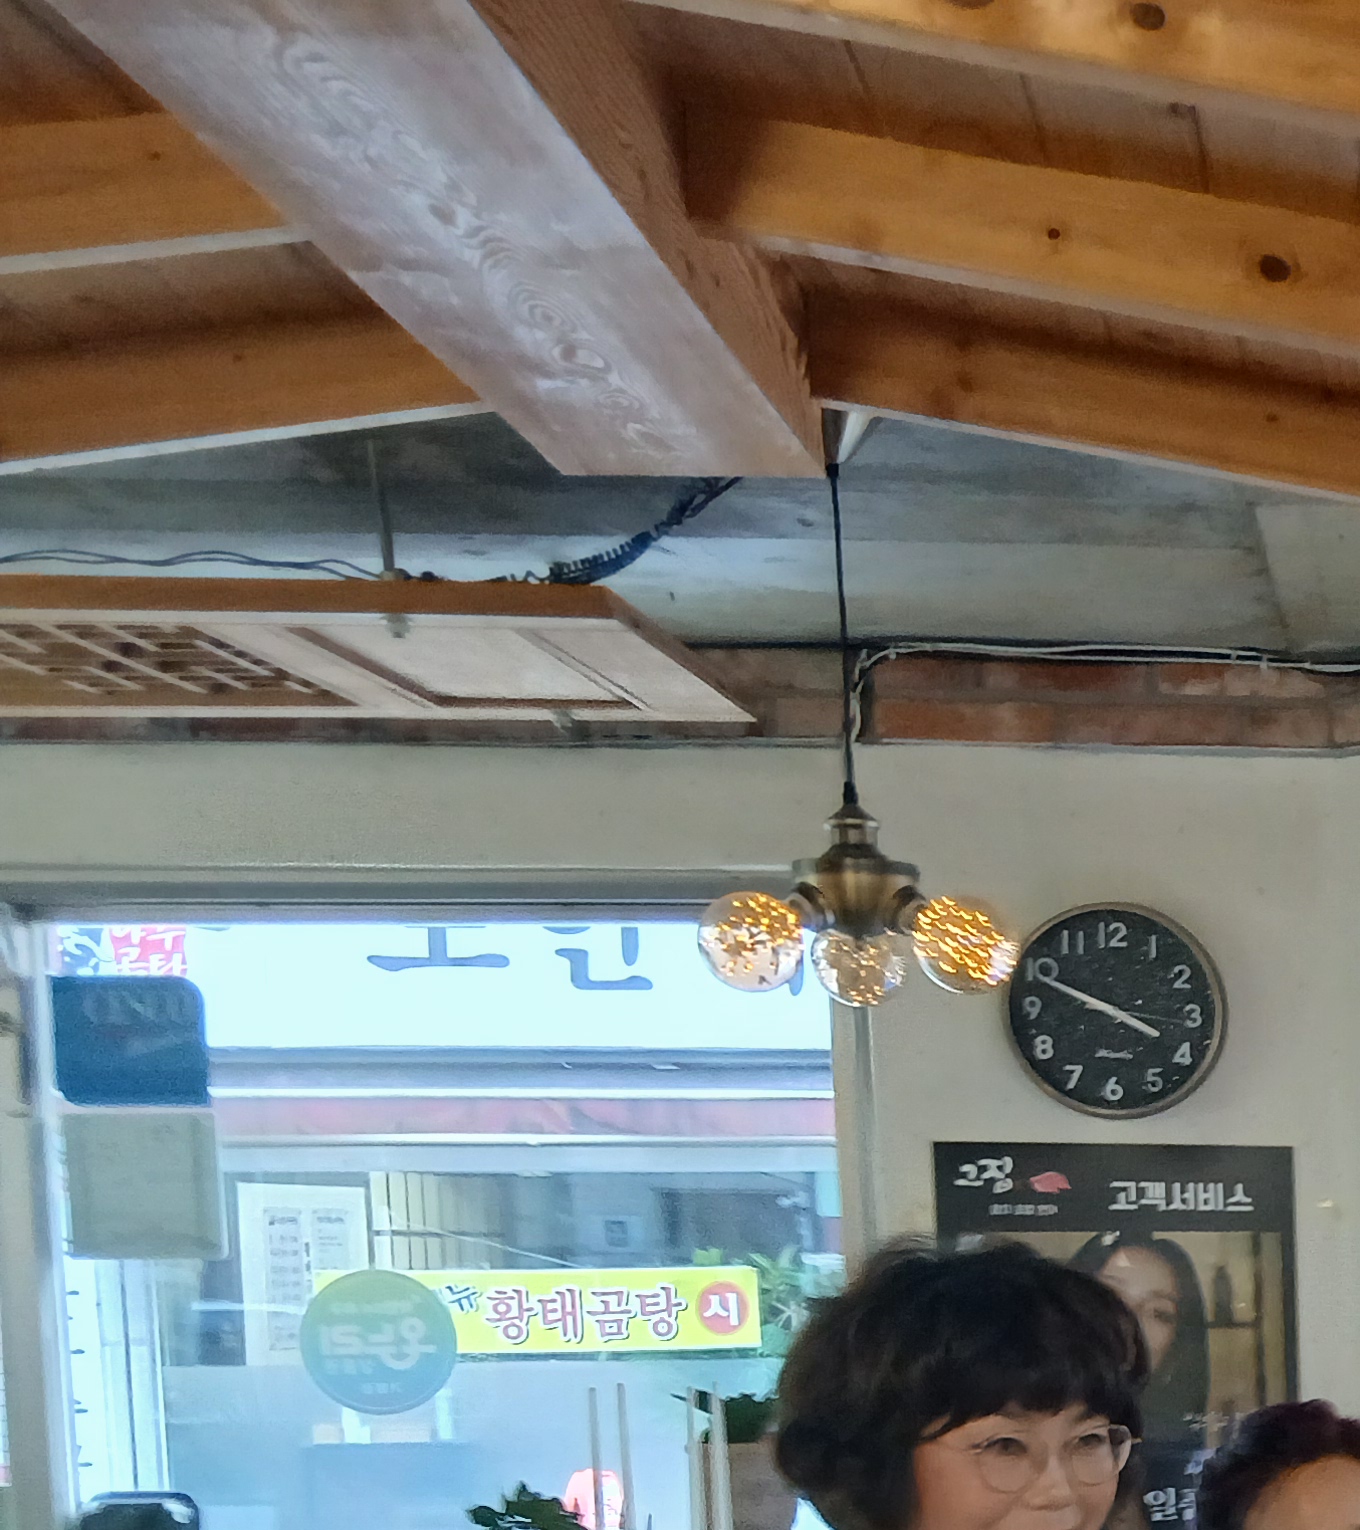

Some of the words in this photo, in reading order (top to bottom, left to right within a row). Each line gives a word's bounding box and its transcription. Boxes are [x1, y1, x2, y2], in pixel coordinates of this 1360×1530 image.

[1060, 929, 1085, 955] 11
[1097, 921, 1129, 949] 12
[1148, 933, 1157, 959] 1
[1024, 957, 1060, 982] 10
[1172, 964, 1192, 989] 2
[1022, 996, 1042, 1020] 9
[1182, 1003, 1203, 1029] 3
[1034, 1034, 1054, 1060] 8
[1172, 1041, 1193, 1066] 4
[1062, 1064, 1084, 1091] 7
[1104, 1076, 1124, 1101] 6
[1146, 1067, 1164, 1093] 5
[1108, 1180, 1255, 1213] 고객서비스
[485, 1283, 687, 1344] 황태곰탕
[704, 1291, 741, 1327] 시
